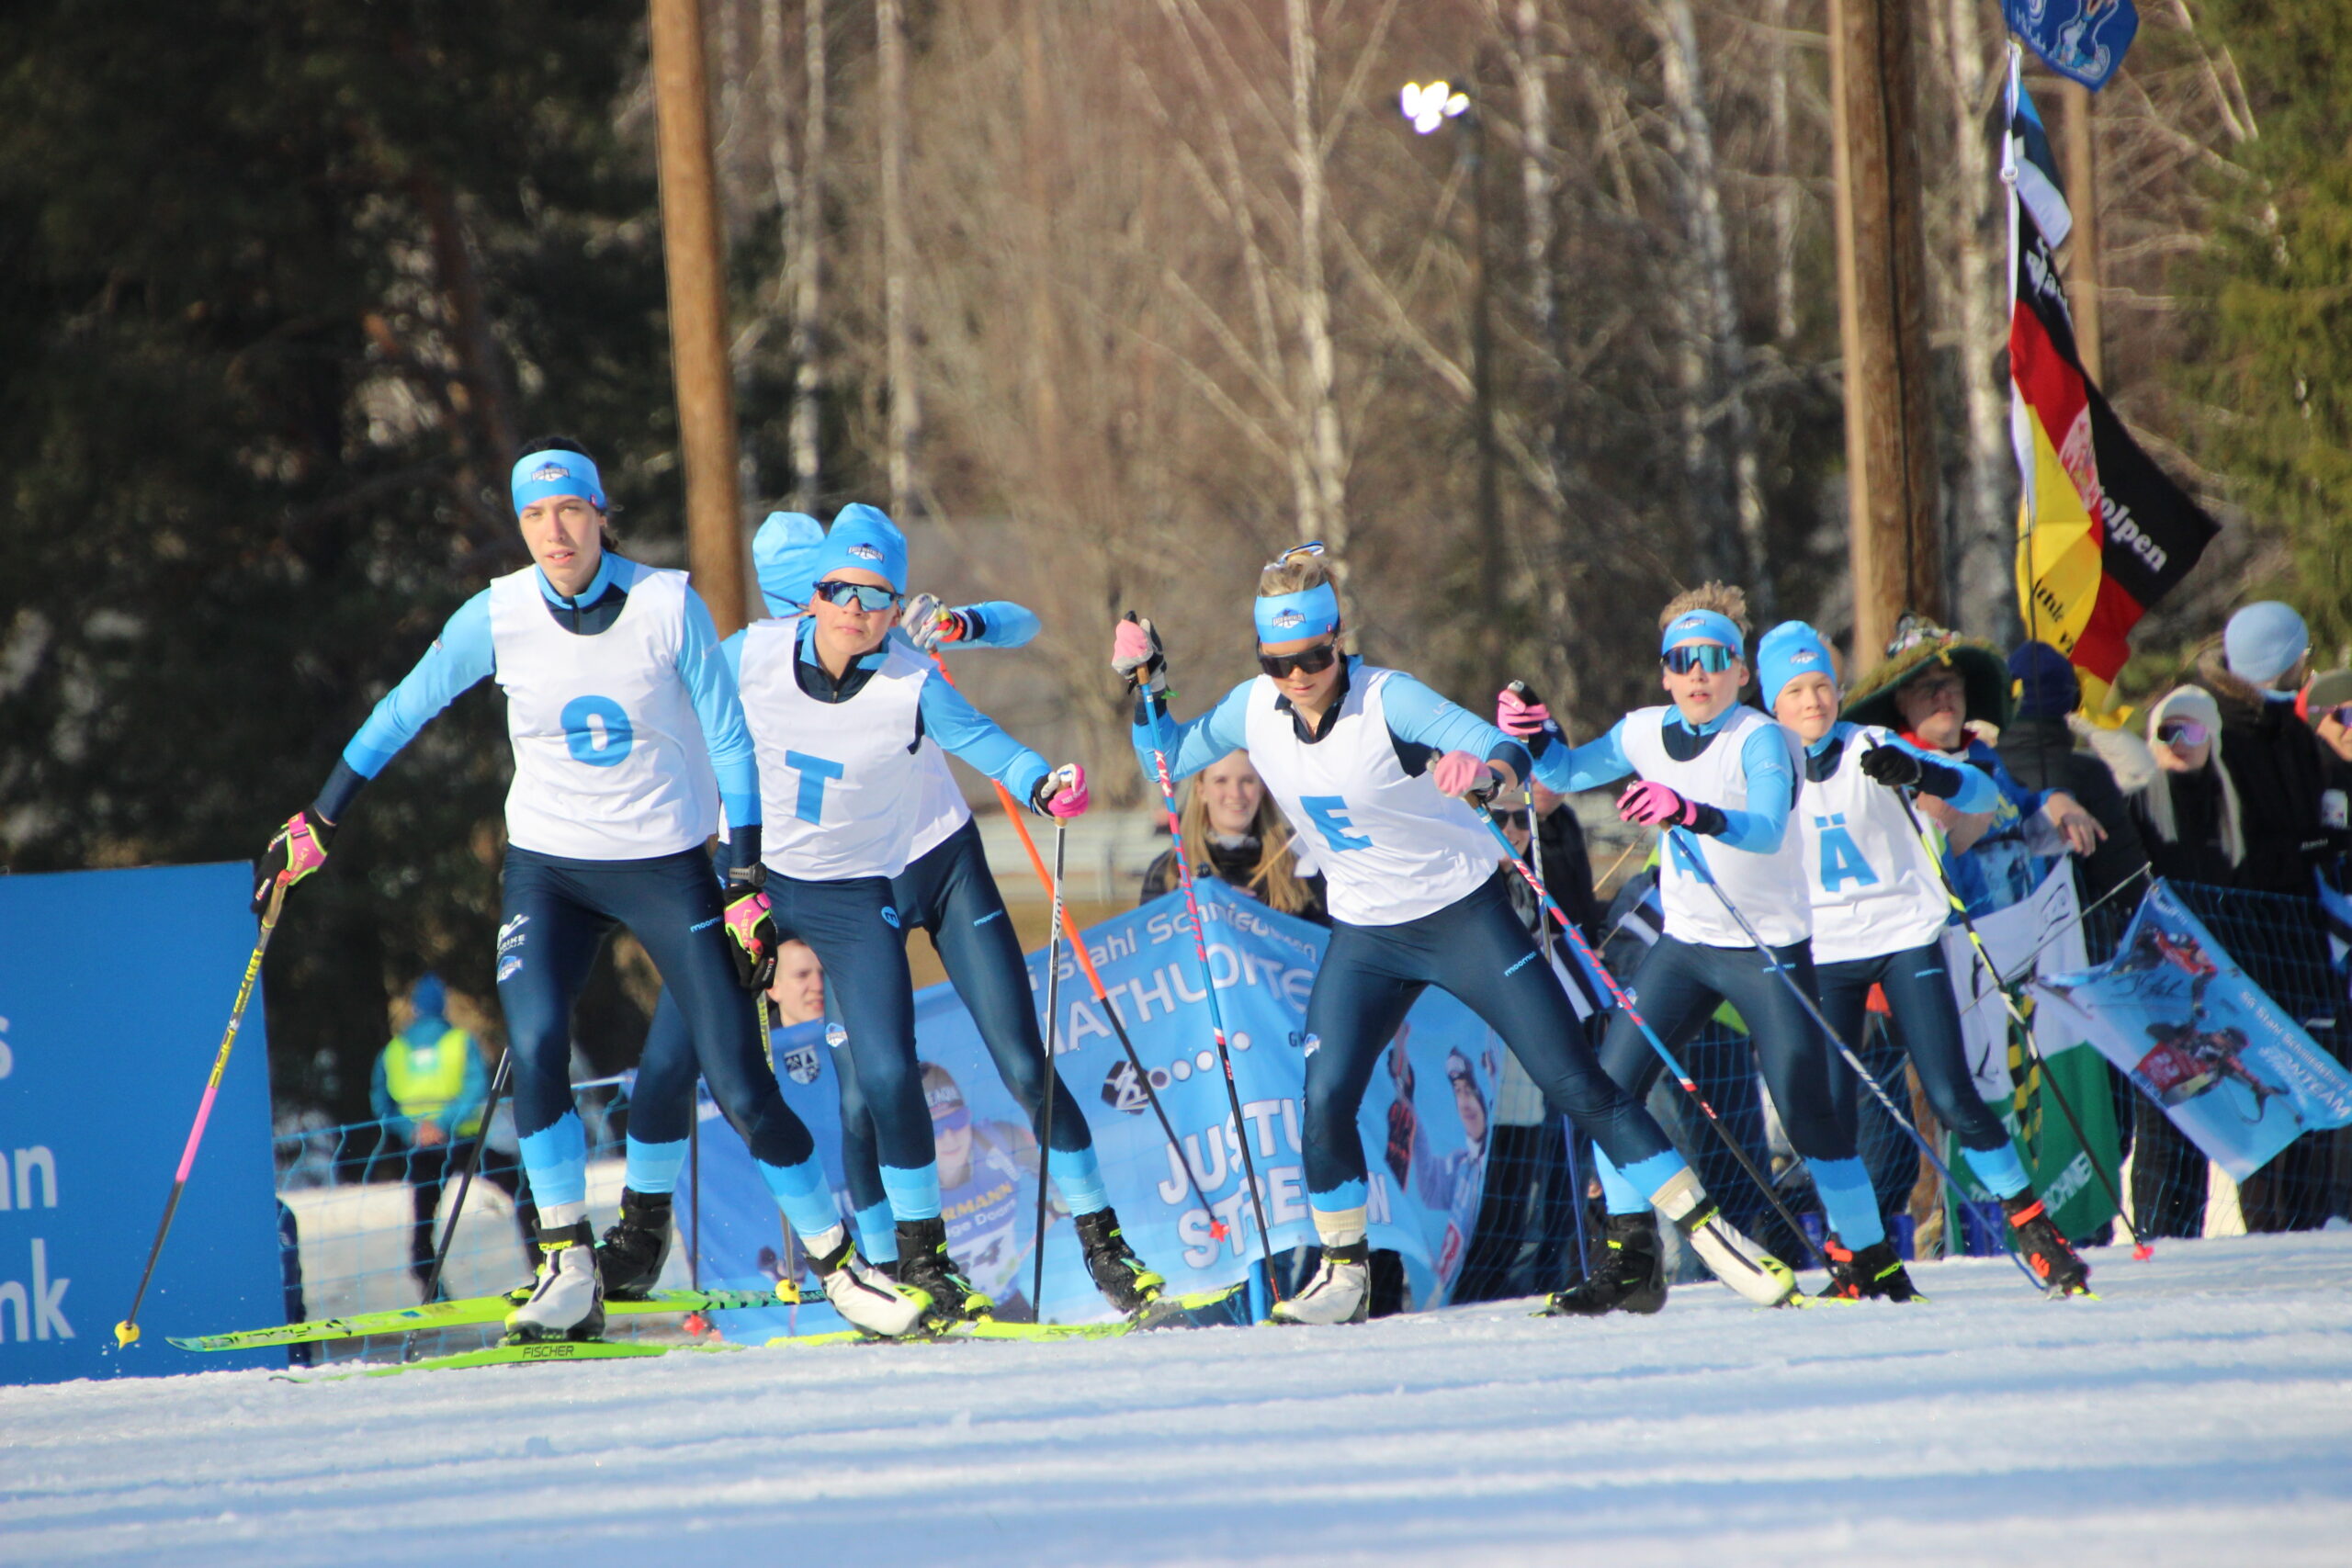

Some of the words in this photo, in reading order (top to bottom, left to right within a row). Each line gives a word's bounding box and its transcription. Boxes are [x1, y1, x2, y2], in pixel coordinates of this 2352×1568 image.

[785, 749, 844, 827] T
[1298, 795, 1374, 852] E
[1814, 812, 1880, 893] Ä
[690, 915, 722, 933] moom
[1050, 928, 1136, 982] Stahl
[1159, 1098, 1305, 1206] JUSTU
[942, 1181, 1013, 1224] RMANN
[522, 1344, 575, 1359] FISCHER
